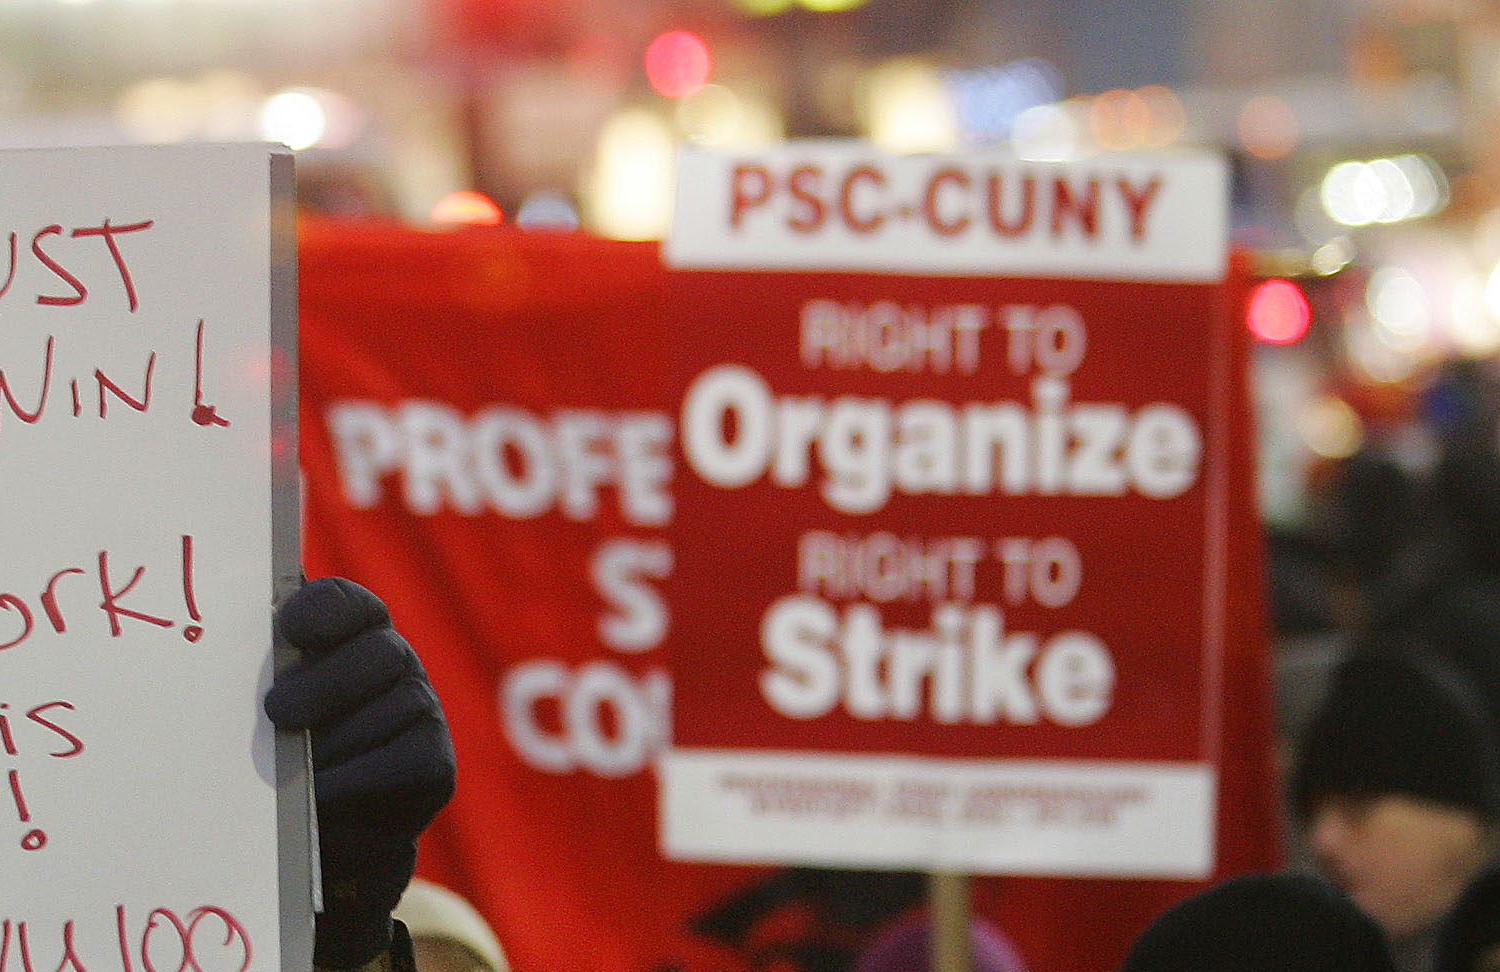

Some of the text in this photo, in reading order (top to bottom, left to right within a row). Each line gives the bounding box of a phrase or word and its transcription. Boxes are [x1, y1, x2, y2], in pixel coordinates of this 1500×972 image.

[728, 162, 1162, 244] PSC-CUNY
[800, 298, 1087, 376] RIGHT TO
[682, 364, 1204, 514] Organize
[797, 531, 1084, 609] RIGHT TO
[758, 597, 1118, 728] Strike
[502, 660, 672, 778] CO
